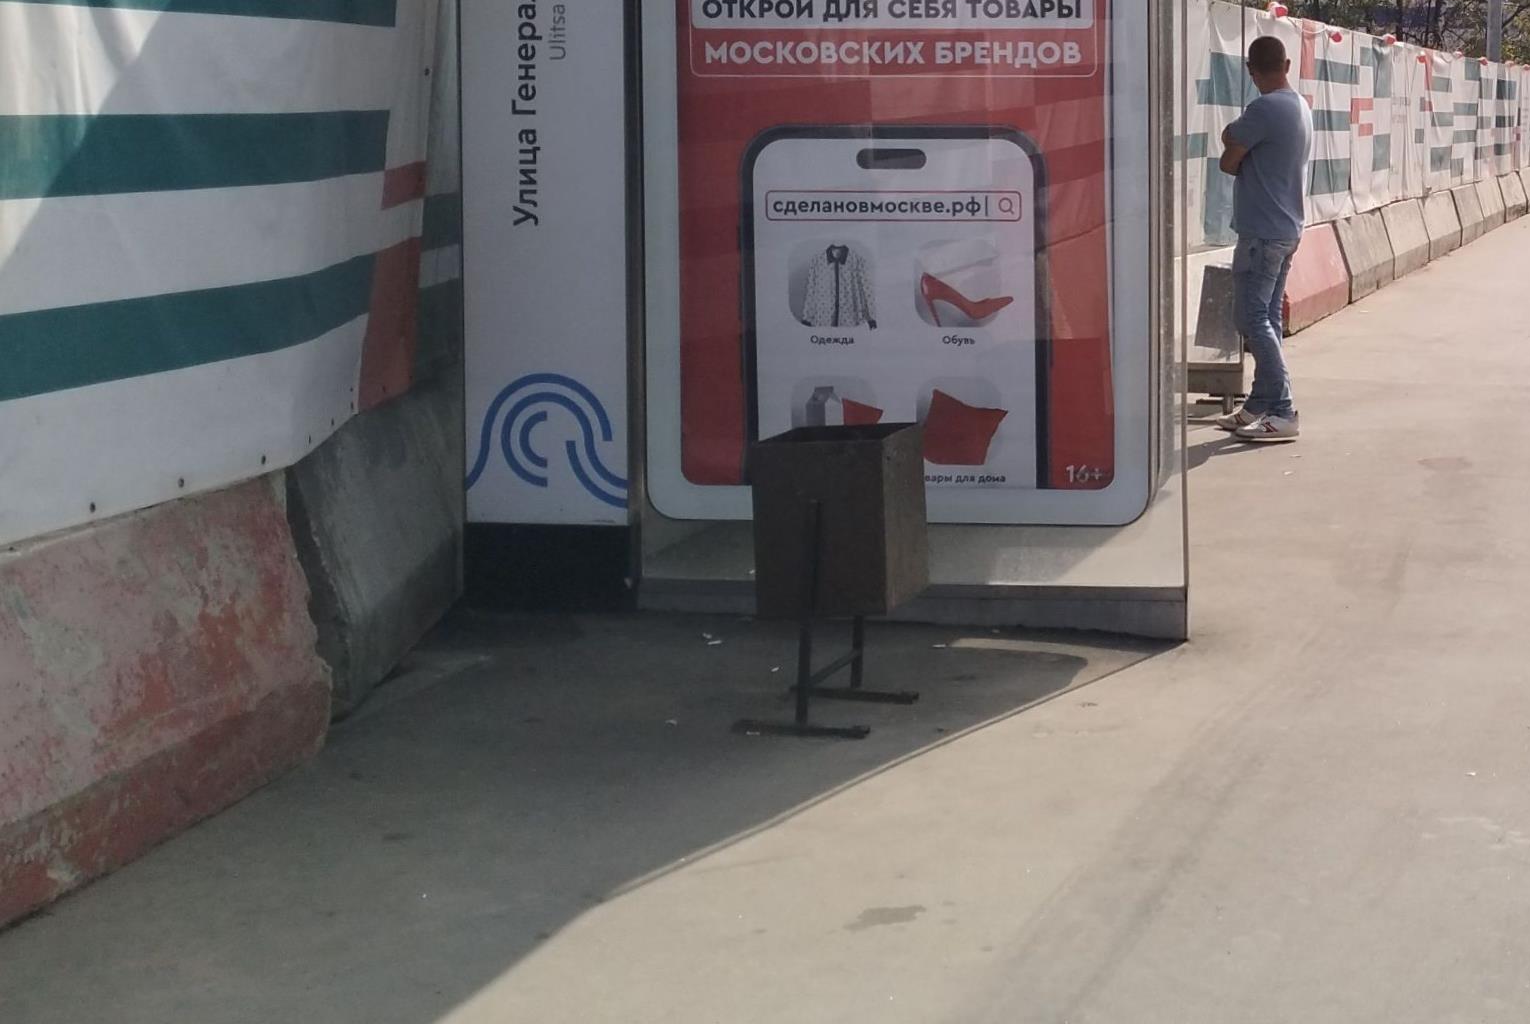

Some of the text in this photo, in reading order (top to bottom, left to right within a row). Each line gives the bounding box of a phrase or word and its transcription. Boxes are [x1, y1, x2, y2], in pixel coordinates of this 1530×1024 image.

[822, 0, 879, 22] ДЛЯ
[887, 0, 957, 19] СЕБЯ
[550, 3, 567, 60] Ulitsa
[705, 41, 1082, 70] МОСКОВСКИХ БРЕНДОВ
[513, 128, 541, 226] Улица
[773, 196, 981, 218] сделановмоскве.рф
[810, 334, 976, 347] Одежда Обувь
[924, 474, 1007, 484] вары для дома
[1065, 465, 1104, 484] 16+
